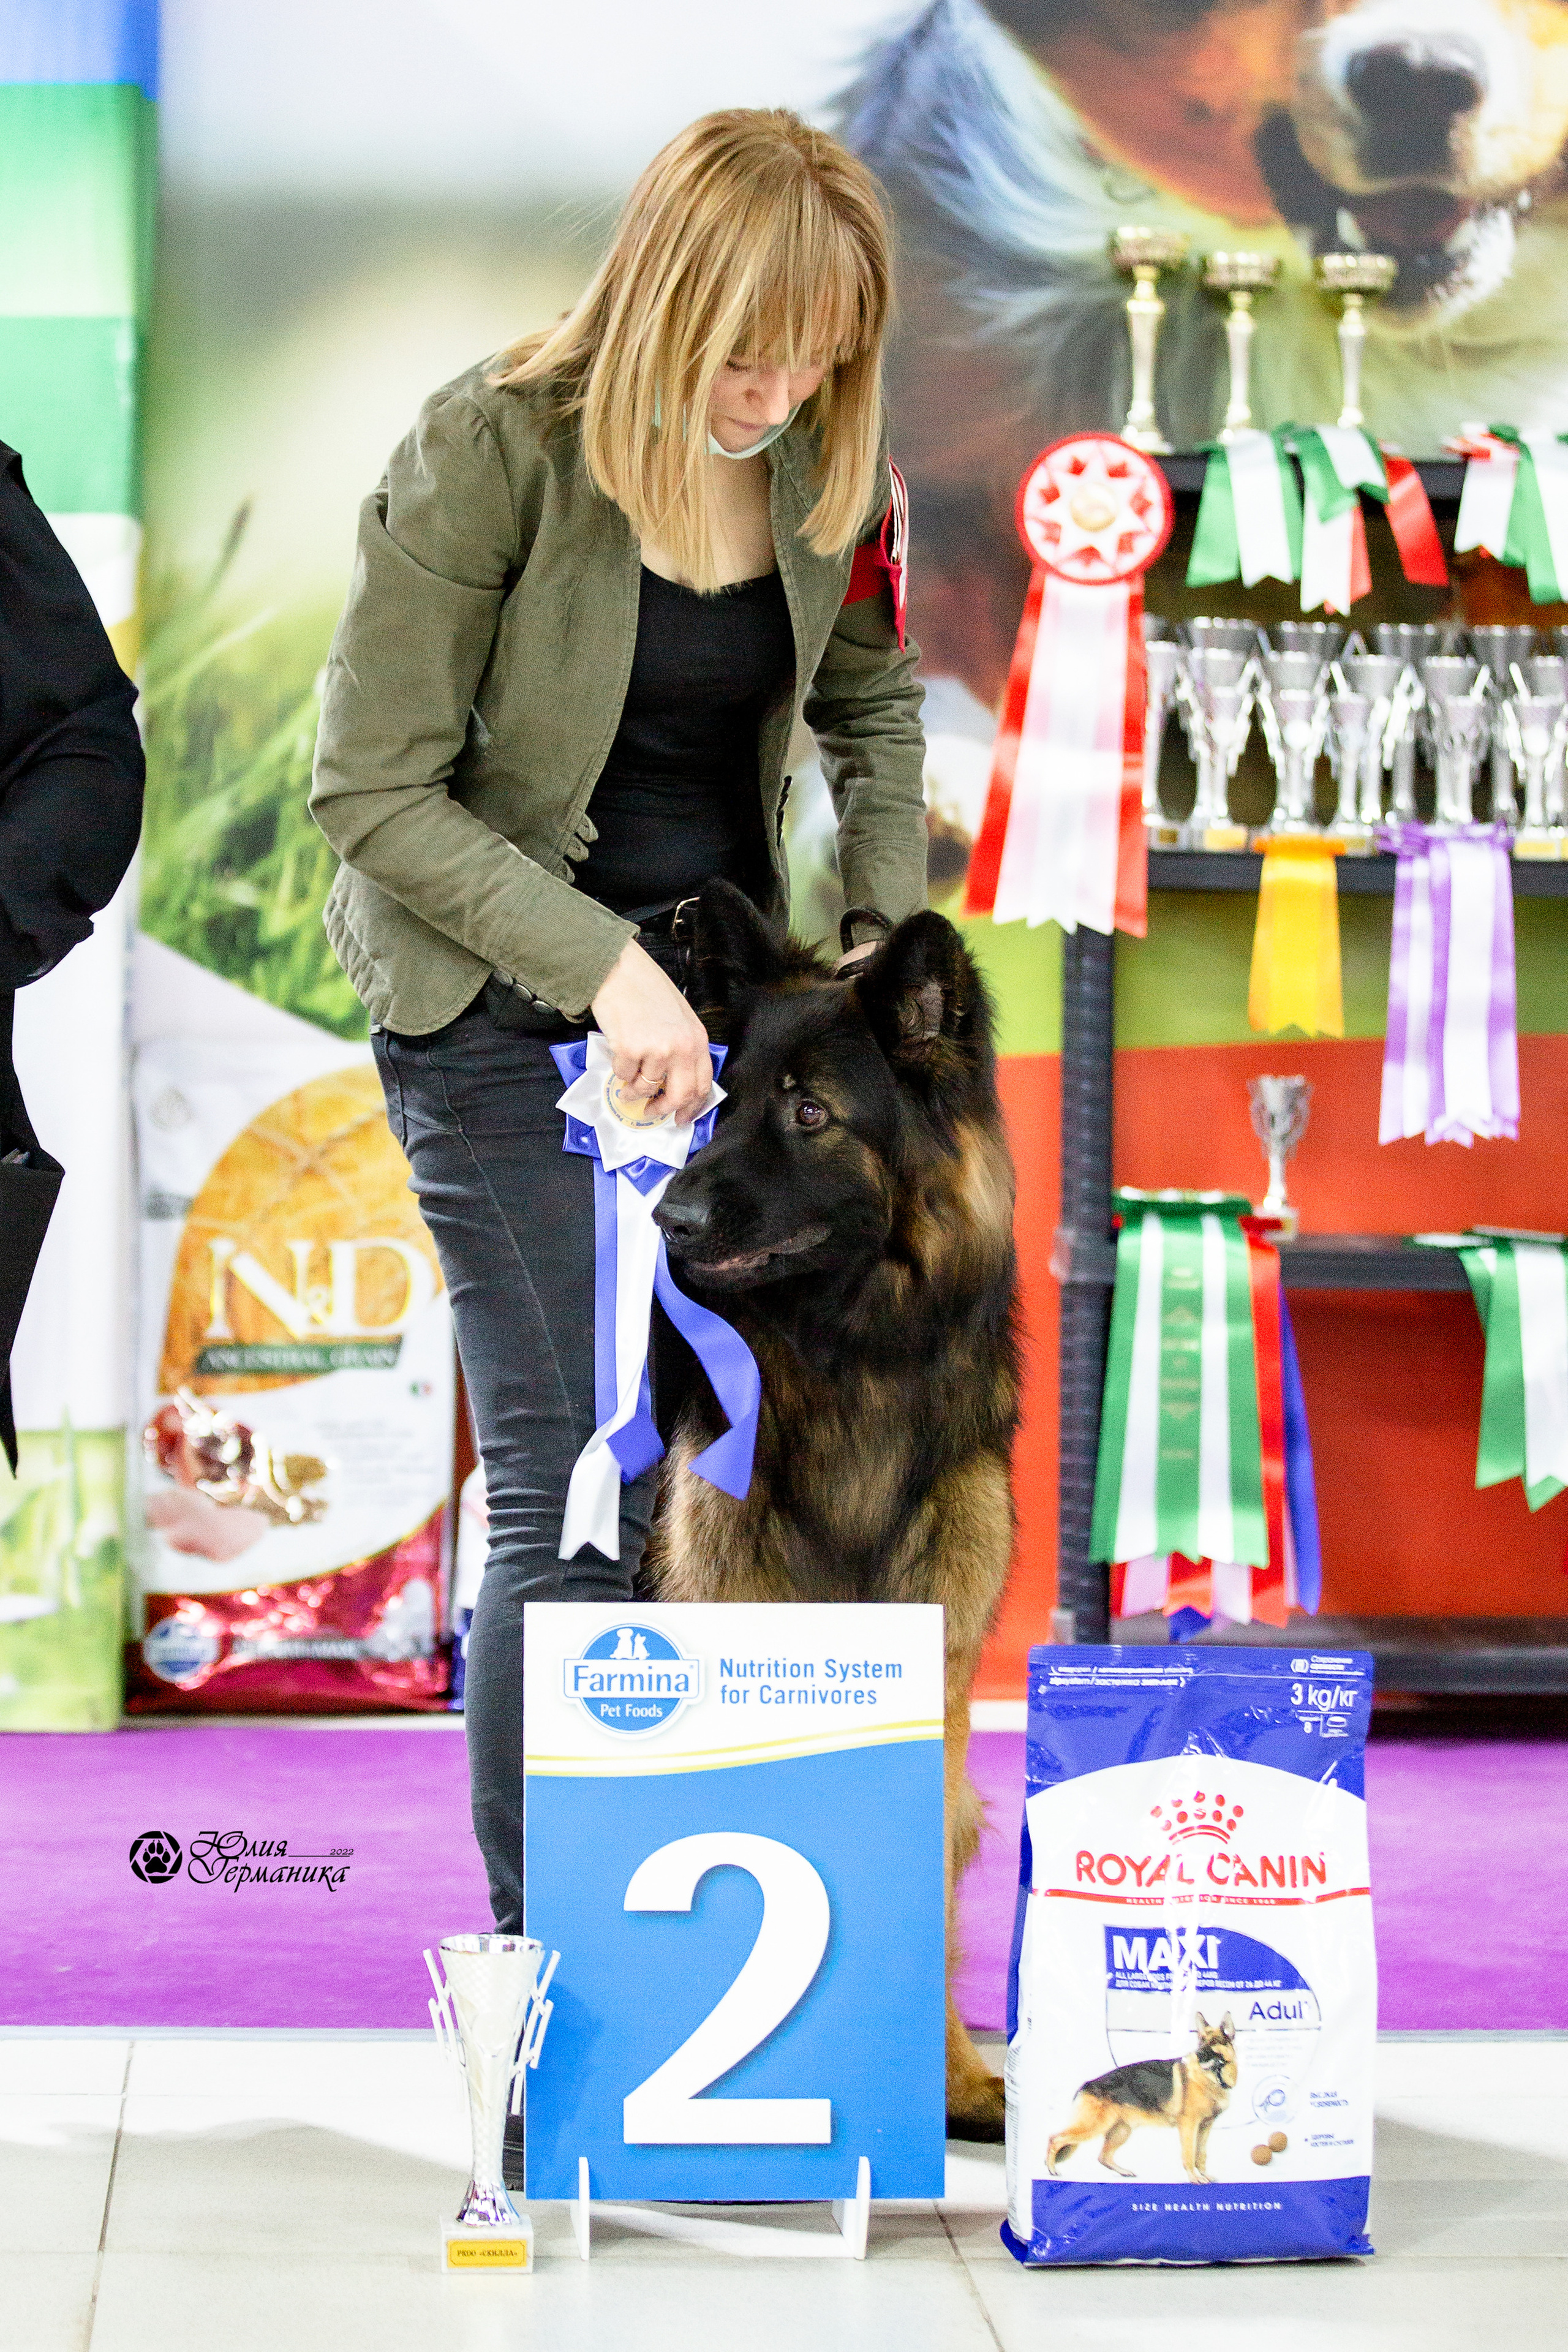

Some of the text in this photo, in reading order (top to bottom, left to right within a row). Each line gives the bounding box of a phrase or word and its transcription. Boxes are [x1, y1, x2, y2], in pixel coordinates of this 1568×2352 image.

[573, 1665, 689, 1692] Farmina
[720, 1657, 903, 1683] Nutrition System
[720, 1684, 877, 1705] for Carnivores
[1290, 1683, 1358, 1712] 3 kg/кг
[600, 1703, 663, 1718] Pet Foods
[1076, 1850, 1327, 1888] ROYAL CANIN
[1112, 1934, 1219, 1971] MAXI
[623, 1831, 832, 2144] 2
[1131, 2201, 1283, 2212] SIZE HEALTH NUTRITION
